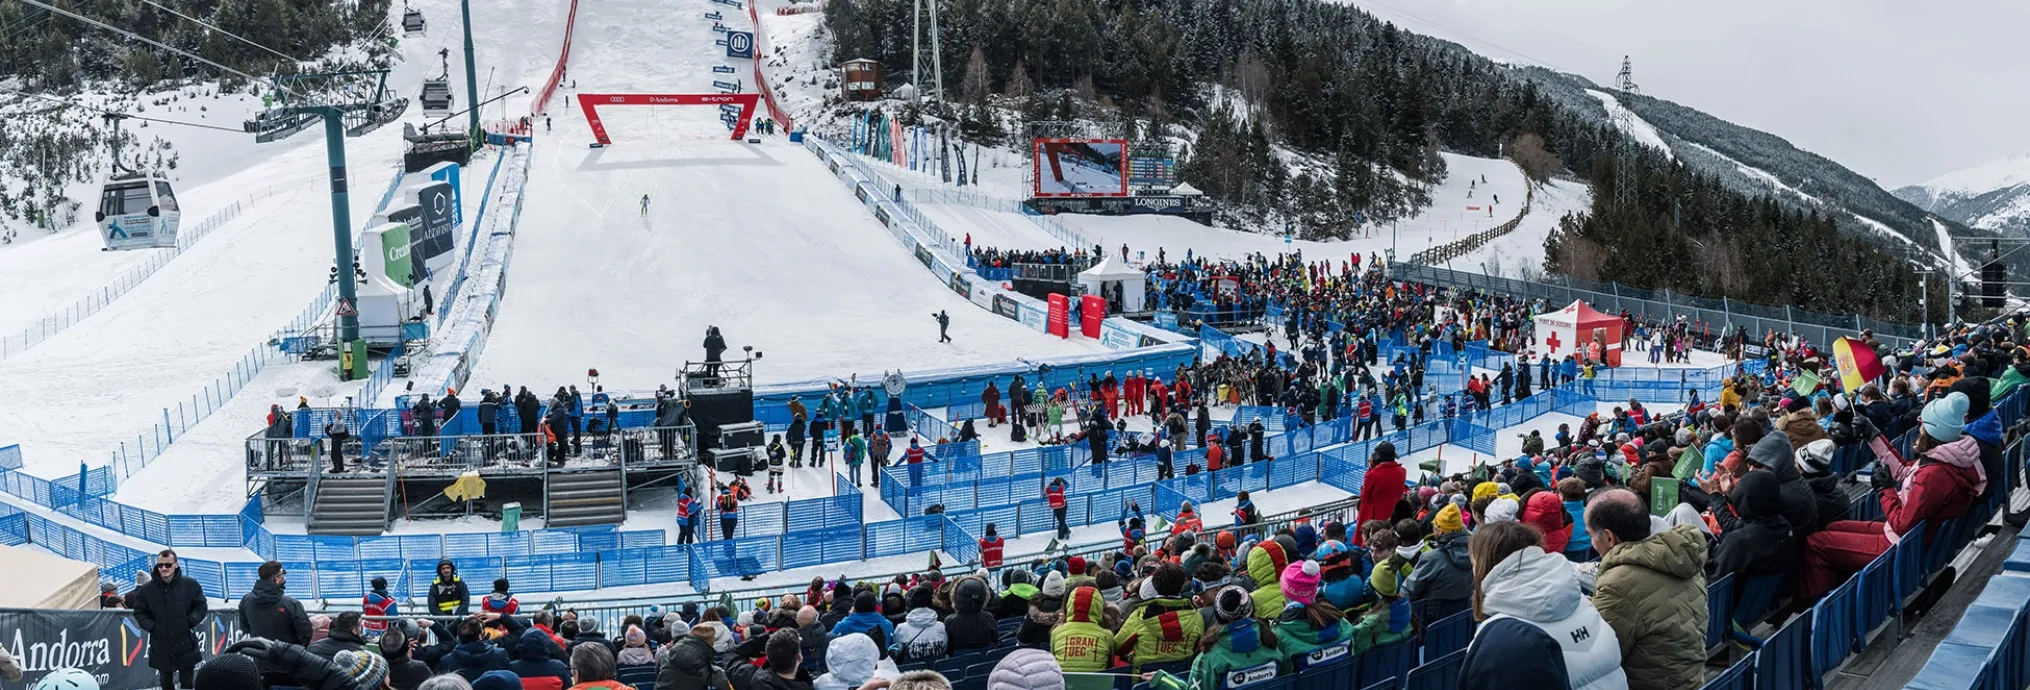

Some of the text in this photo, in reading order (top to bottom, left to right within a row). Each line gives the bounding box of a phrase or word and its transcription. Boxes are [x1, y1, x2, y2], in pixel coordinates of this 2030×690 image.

[1135, 199, 1181, 207] LONGINES
[1656, 484, 1664, 511] Creand
[1570, 626, 1590, 644] HH
[1069, 637, 1095, 648] GRAN
[1160, 642, 1178, 653] UEC
[11, 627, 111, 672] Andorra
[1068, 647, 1087, 657] UEC
